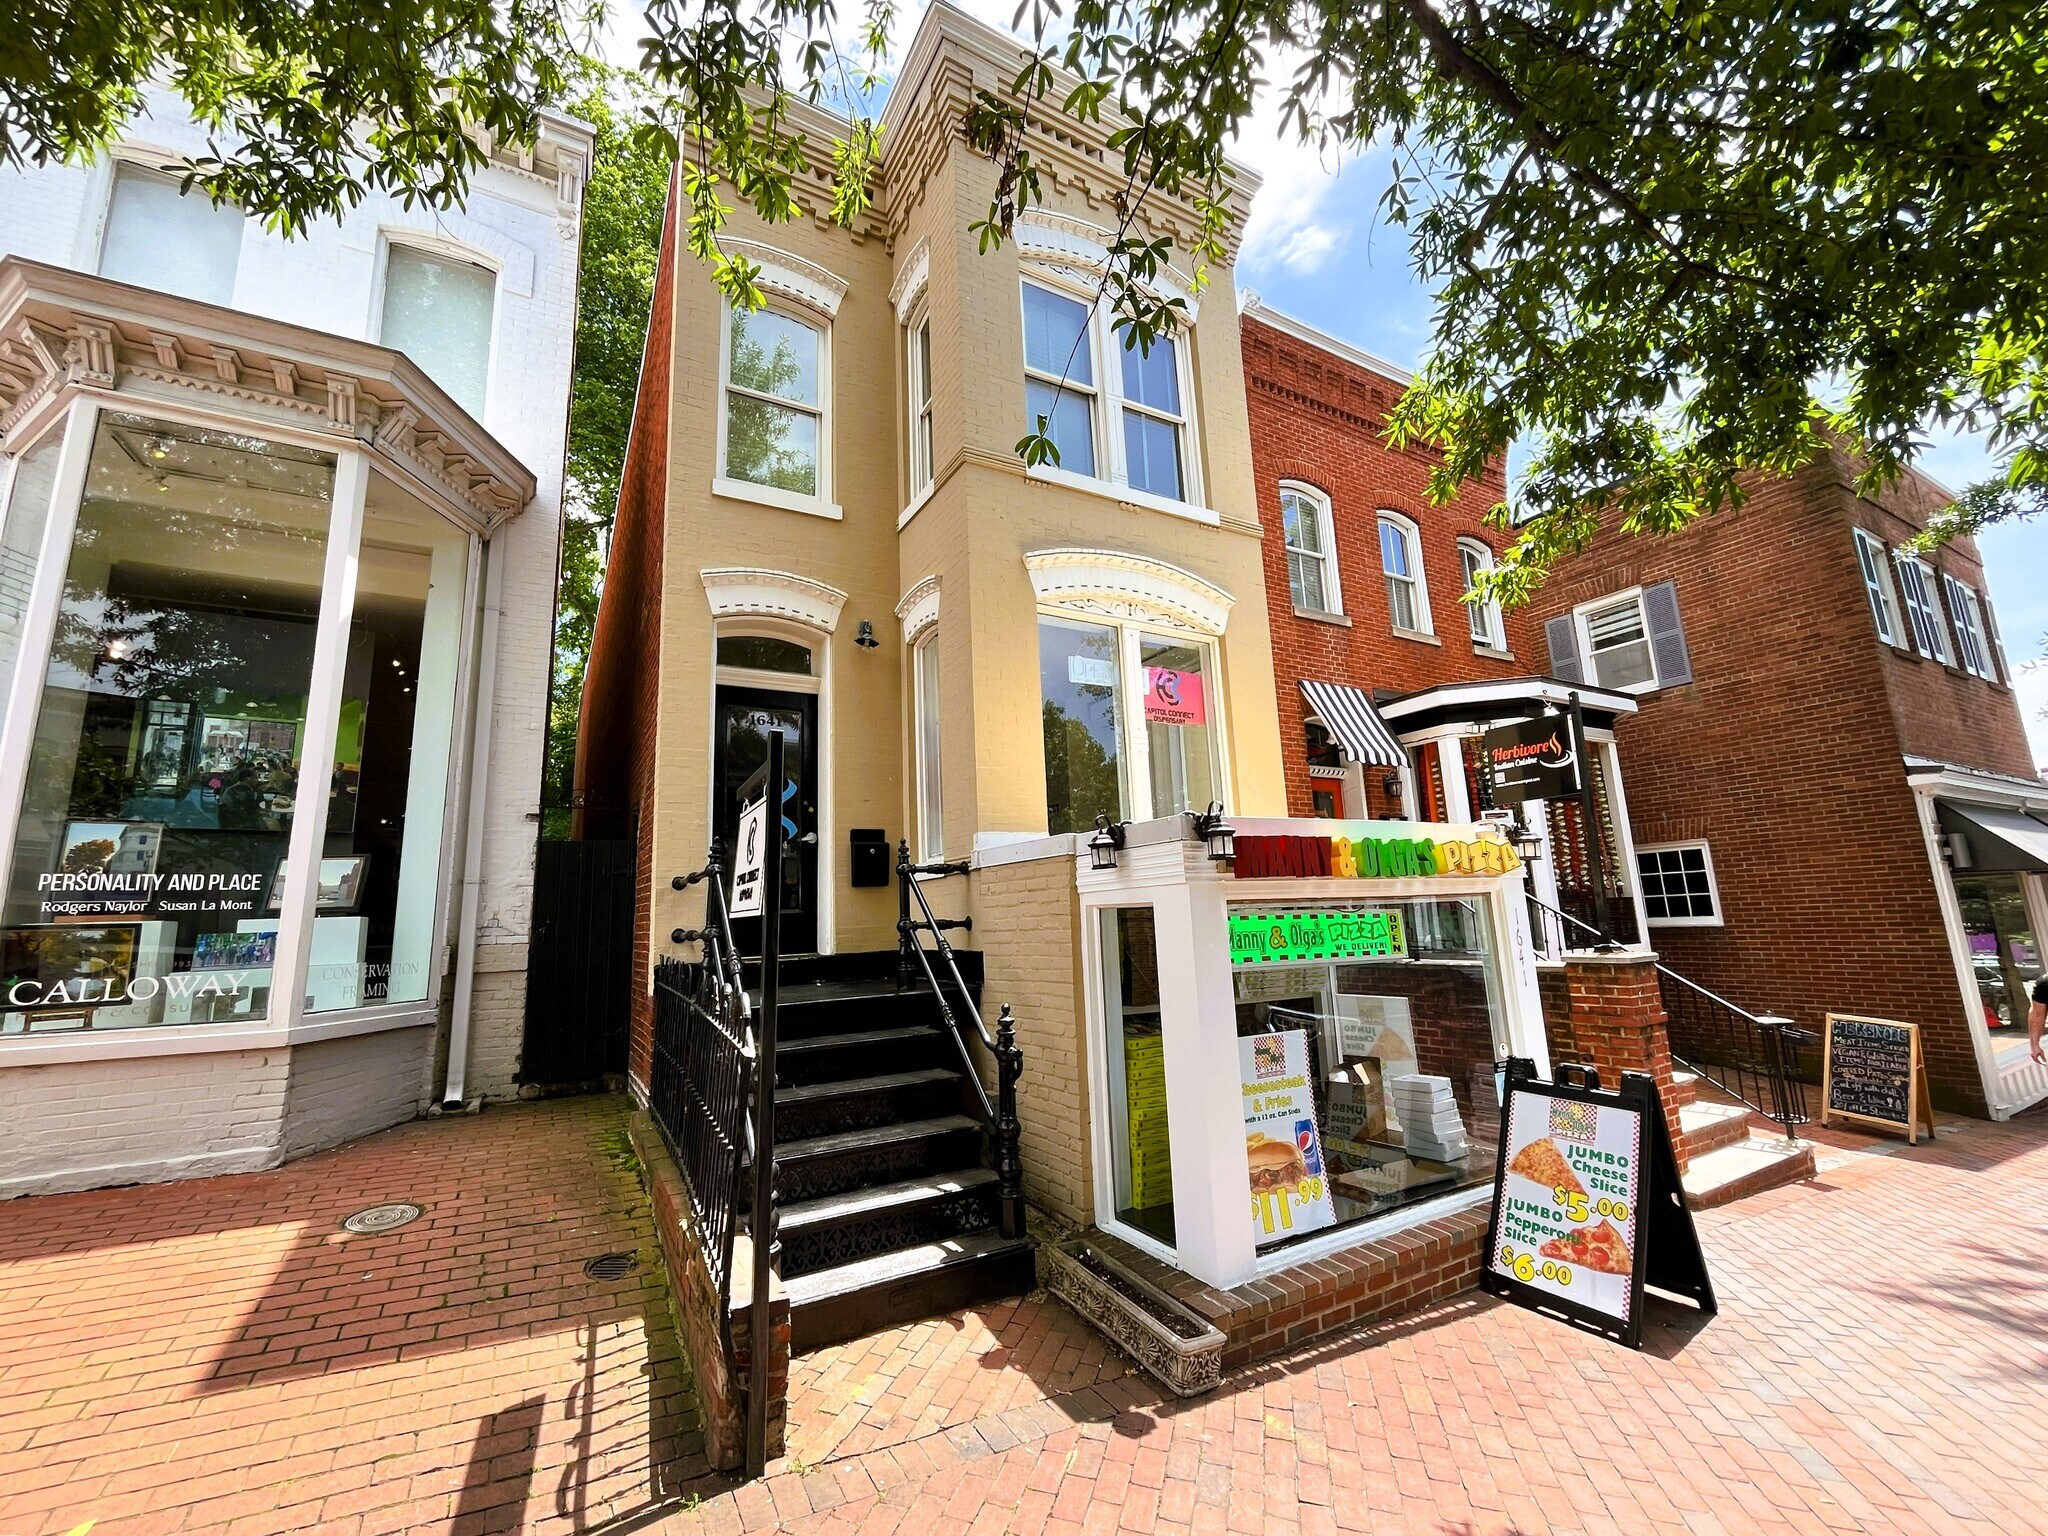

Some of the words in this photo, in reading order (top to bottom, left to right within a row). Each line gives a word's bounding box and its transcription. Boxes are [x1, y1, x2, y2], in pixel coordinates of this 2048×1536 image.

[750, 714, 782, 727] 1641
[1492, 741, 1549, 762] Herbivore
[1235, 836, 1333, 878] MANNY
[1334, 836, 1358, 877] &
[1356, 837, 1437, 876] OLGA'S
[1438, 838, 1521, 874] PIZZA
[38, 872, 165, 892] PERSONALITY
[167, 873, 205, 891] AND
[208, 873, 263, 891] PLACE
[41, 901, 101, 915] Rodgers
[104, 900, 149, 914] Naylor
[158, 900, 197, 912] Susan
[201, 900, 217, 911] La
[220, 900, 253, 911] Mont
[1269, 926, 1288, 949] &
[1289, 921, 1325, 952] Olga's
[1328, 920, 1387, 941] PIZZA
[1389, 914, 1403, 953] OPEN
[1334, 943, 1348, 951] WE
[322, 961, 420, 981] CONSERVATION
[8, 972, 250, 1007] CALLOWAY
[1832, 1021, 1908, 1042] HERBIVORE
[1253, 1098, 1263, 1113] &
[1265, 1094, 1293, 1110] Fries
[1833, 1088, 1855, 1100] Beer
[1556, 1129, 1588, 1140] PIZZA
[1567, 1145, 1629, 1168] JUMBO
[1572, 1161, 1628, 1183] Cheese
[1590, 1178, 1628, 1196] Slice
[1506, 1197, 1563, 1222] JUMBO
[1552, 1184, 1629, 1223] $5.00
[1504, 1227, 1537, 1246] Slice
[1501, 1245, 1572, 1285] $6.00
